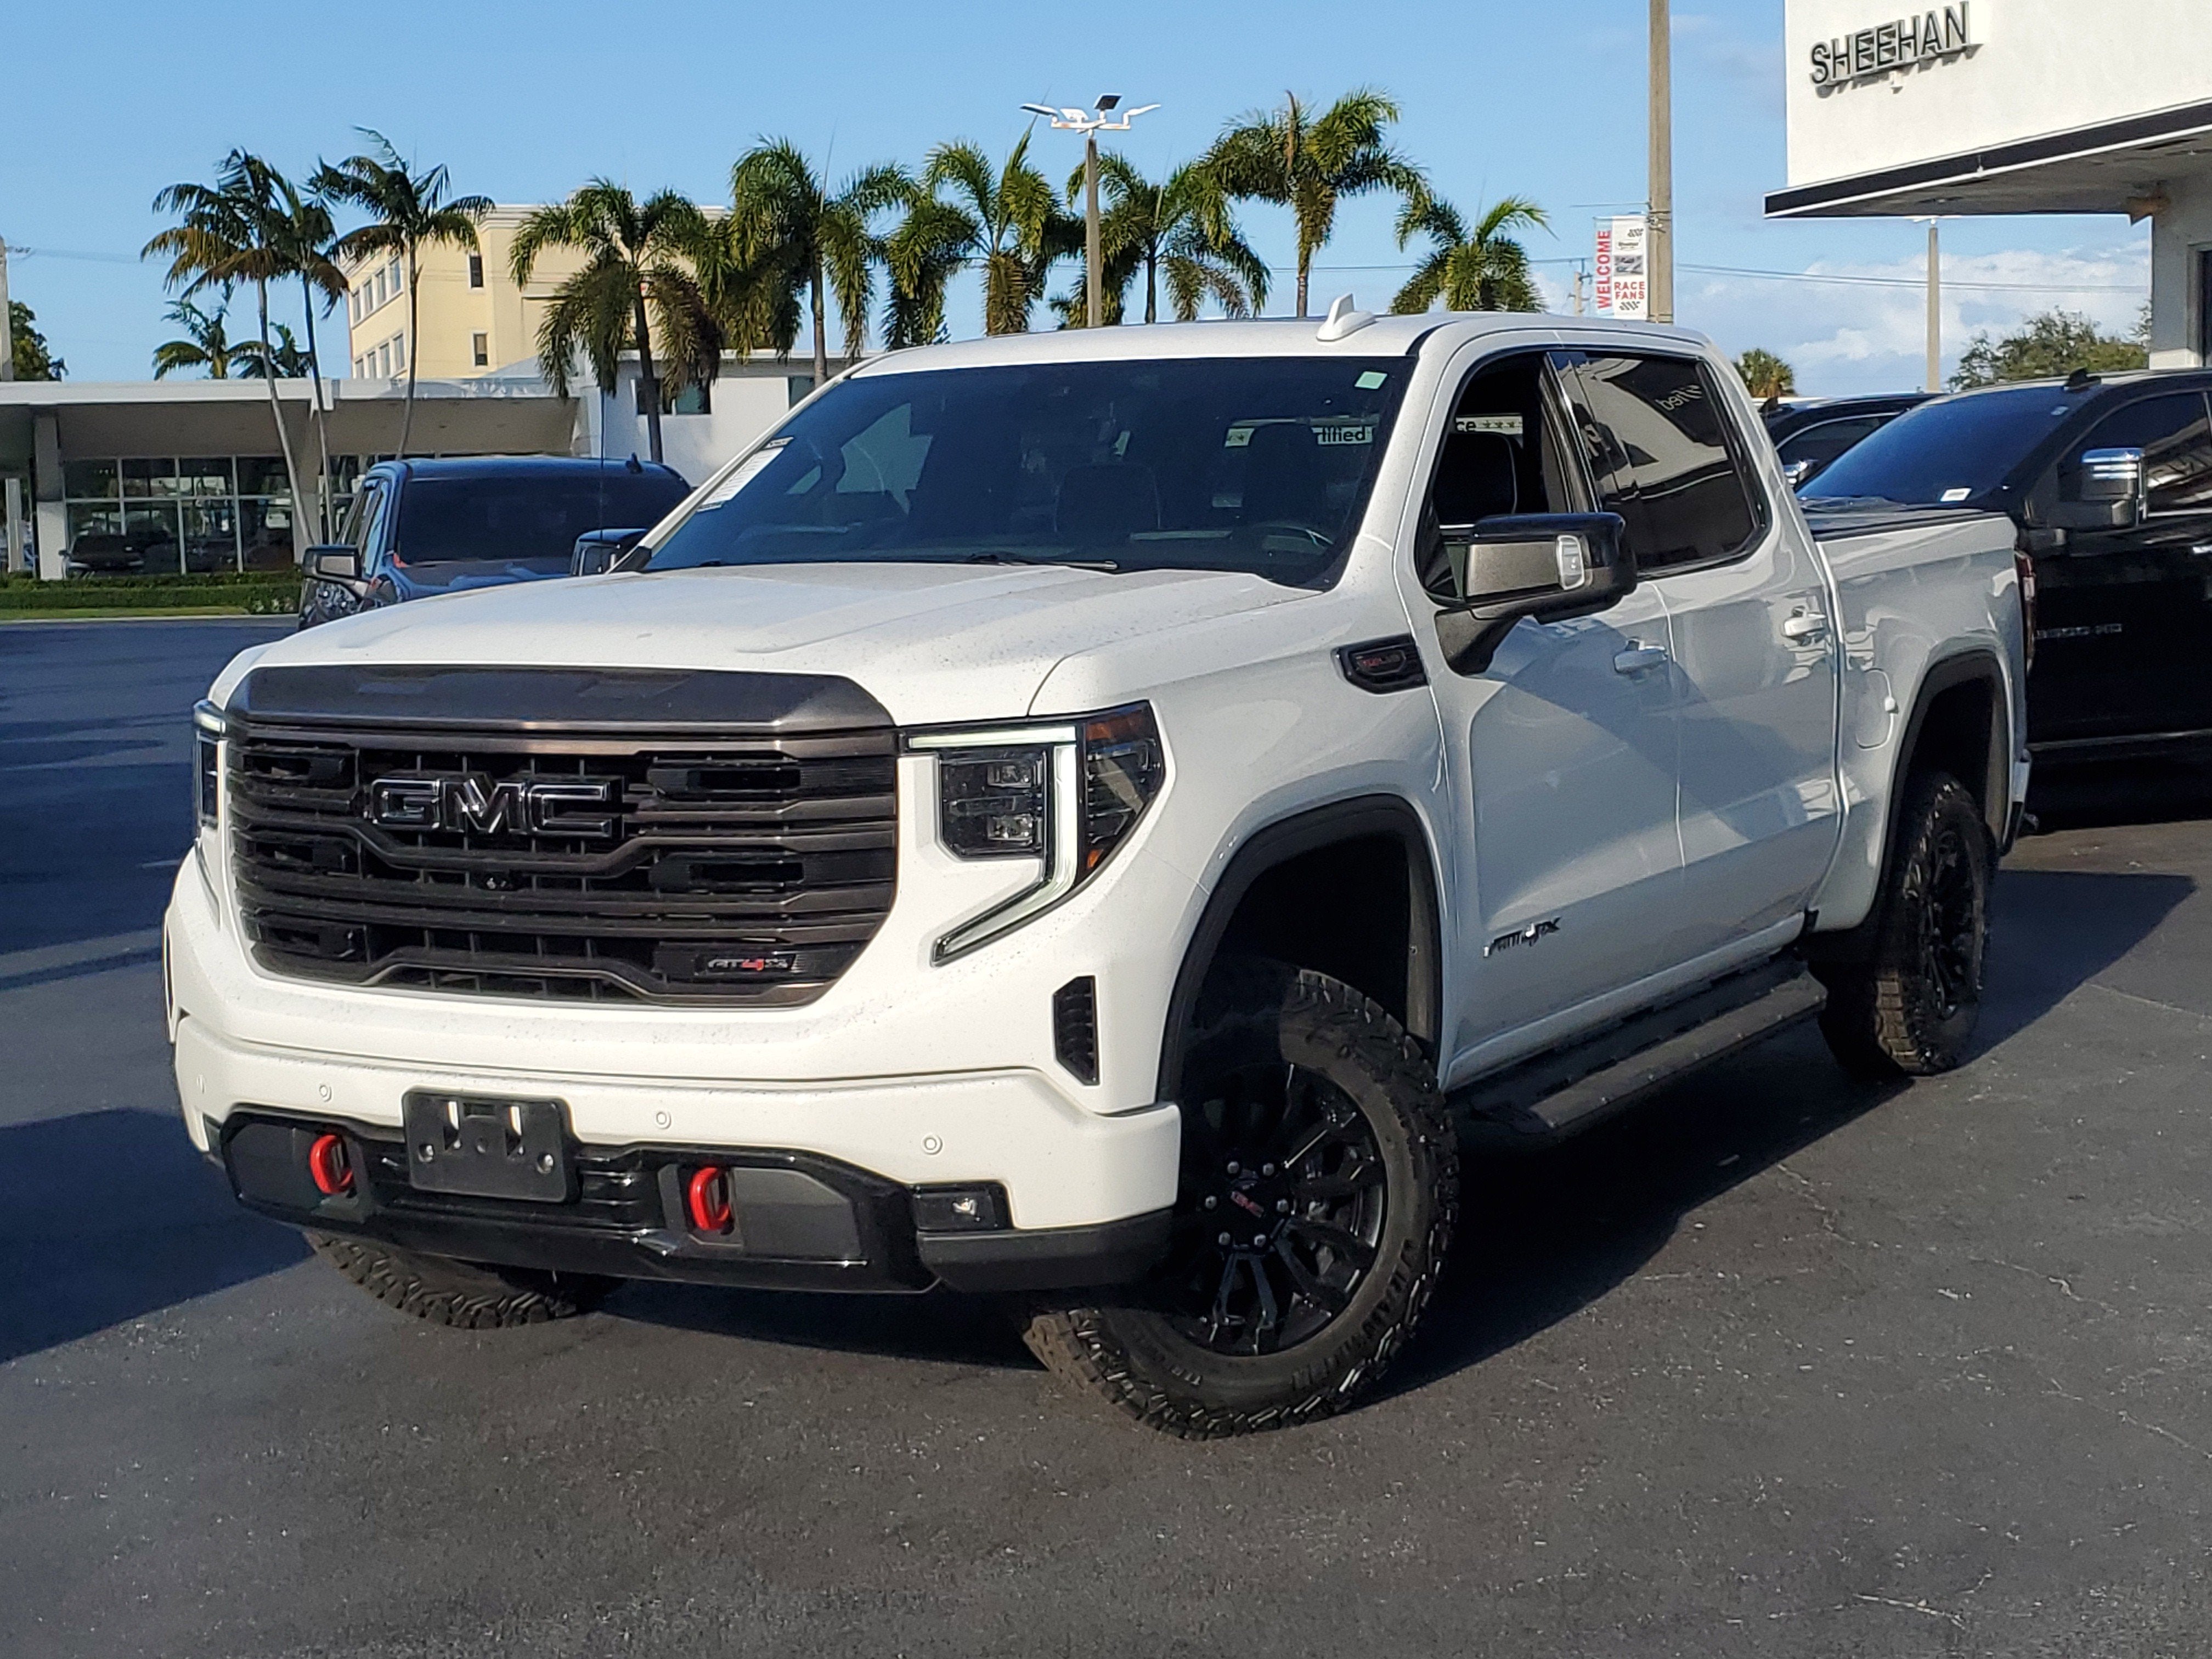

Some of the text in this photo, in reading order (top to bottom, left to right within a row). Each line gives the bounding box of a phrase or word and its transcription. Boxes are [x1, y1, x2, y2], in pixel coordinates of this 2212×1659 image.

[1810, 1, 1972, 84] SHEEHAN
[1597, 230, 1611, 309] WELCOME
[1615, 291, 1645, 300] FANS
[370, 774, 617, 838] GMC
